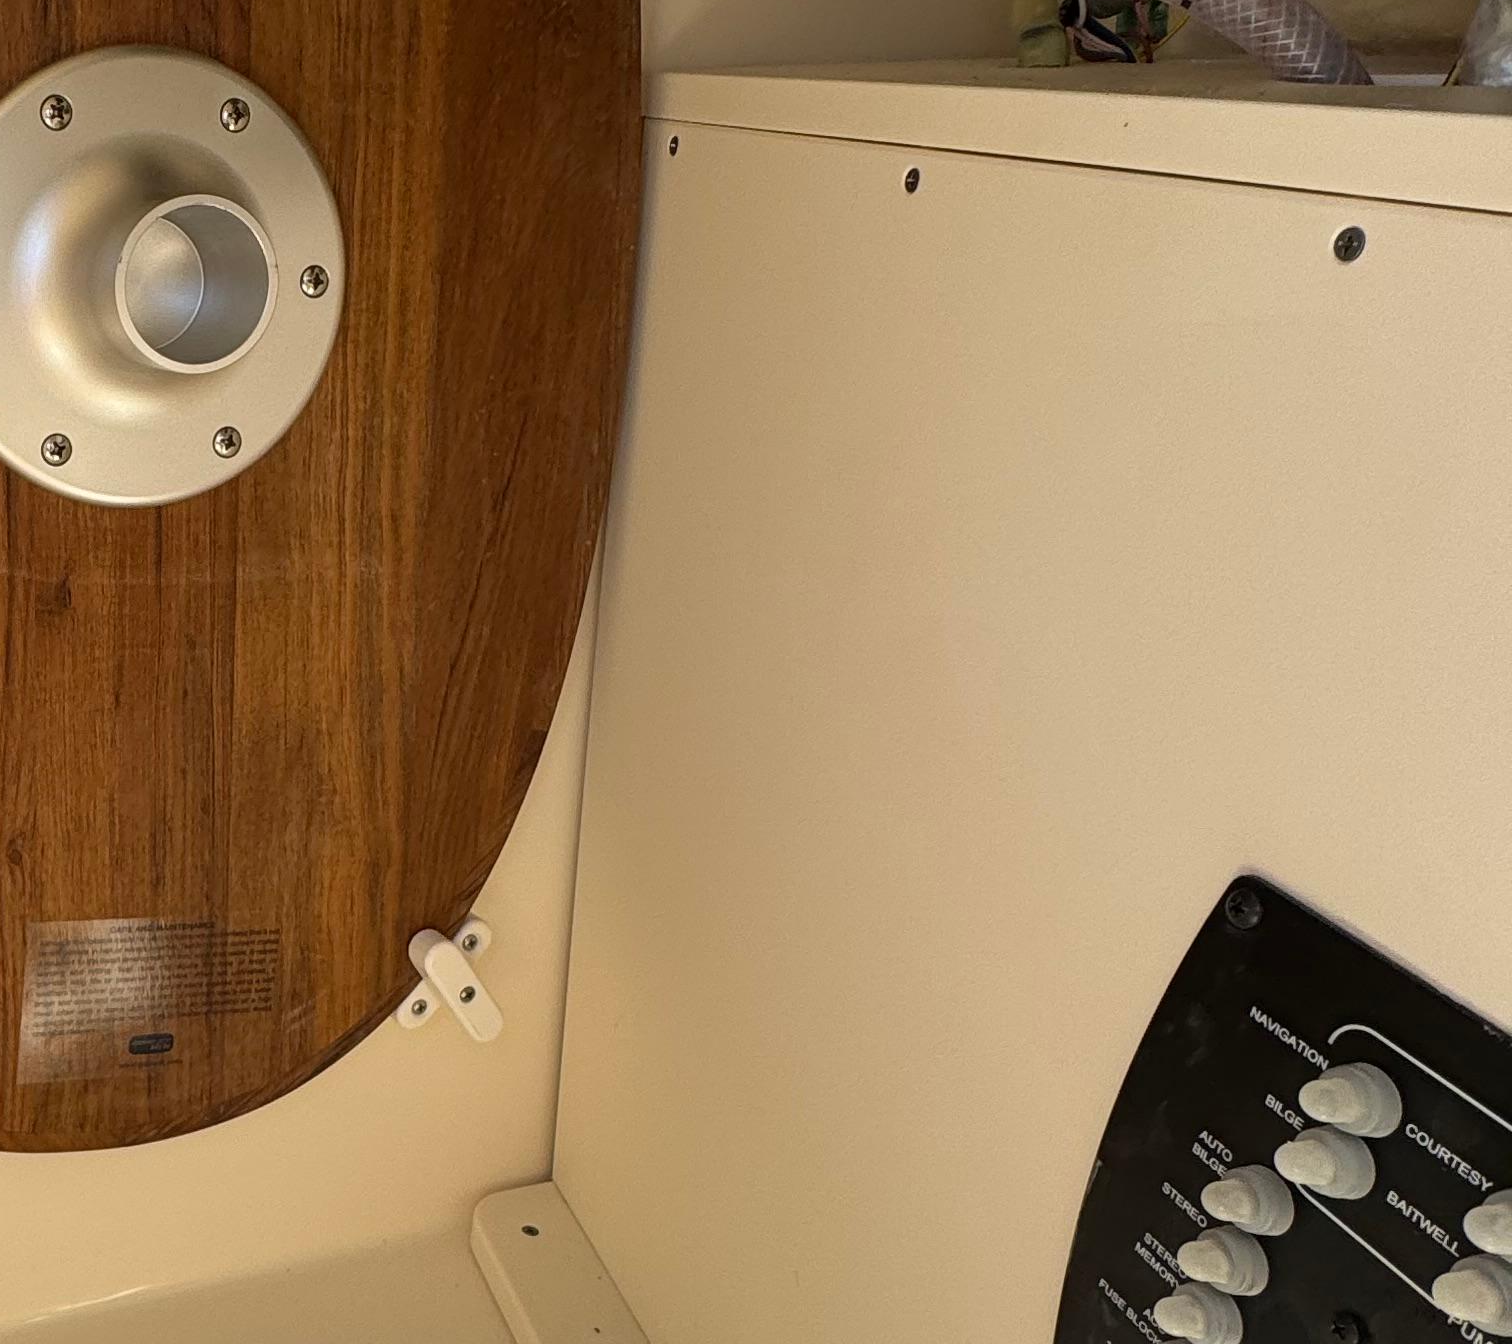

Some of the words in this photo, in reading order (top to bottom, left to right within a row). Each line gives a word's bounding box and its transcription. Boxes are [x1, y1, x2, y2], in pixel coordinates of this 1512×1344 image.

[1249, 1006, 1330, 1071] NAVIGATION
[1264, 1093, 1305, 1131] BILGE
[1191, 1142, 1228, 1177] BILGE
[1198, 1130, 1233, 1162] AUTO
[1405, 1123, 1494, 1192] COURTESY
[1161, 1181, 1208, 1228] STEREO
[1386, 1190, 1460, 1258] BAITWELL
[1098, 1277, 1127, 1311] FUSE
